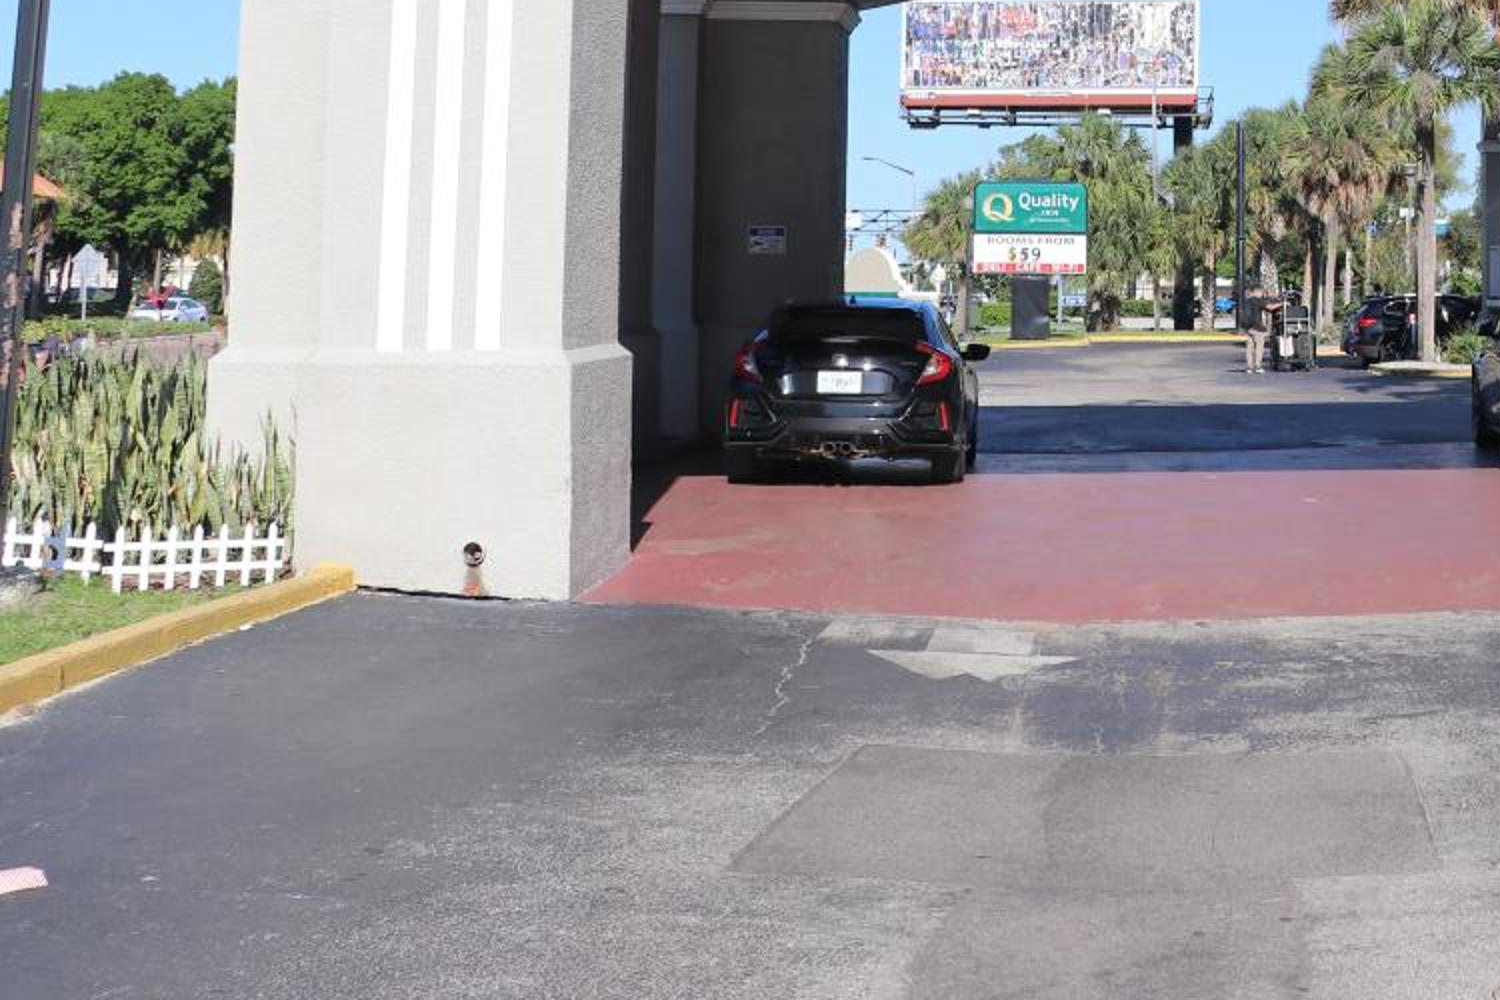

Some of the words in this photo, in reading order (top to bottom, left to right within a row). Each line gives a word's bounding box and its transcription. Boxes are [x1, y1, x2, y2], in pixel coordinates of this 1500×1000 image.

[983, 193, 1016, 221] Q
[1018, 192, 1079, 212] Quality
[1037, 236, 1075, 245] FROM
